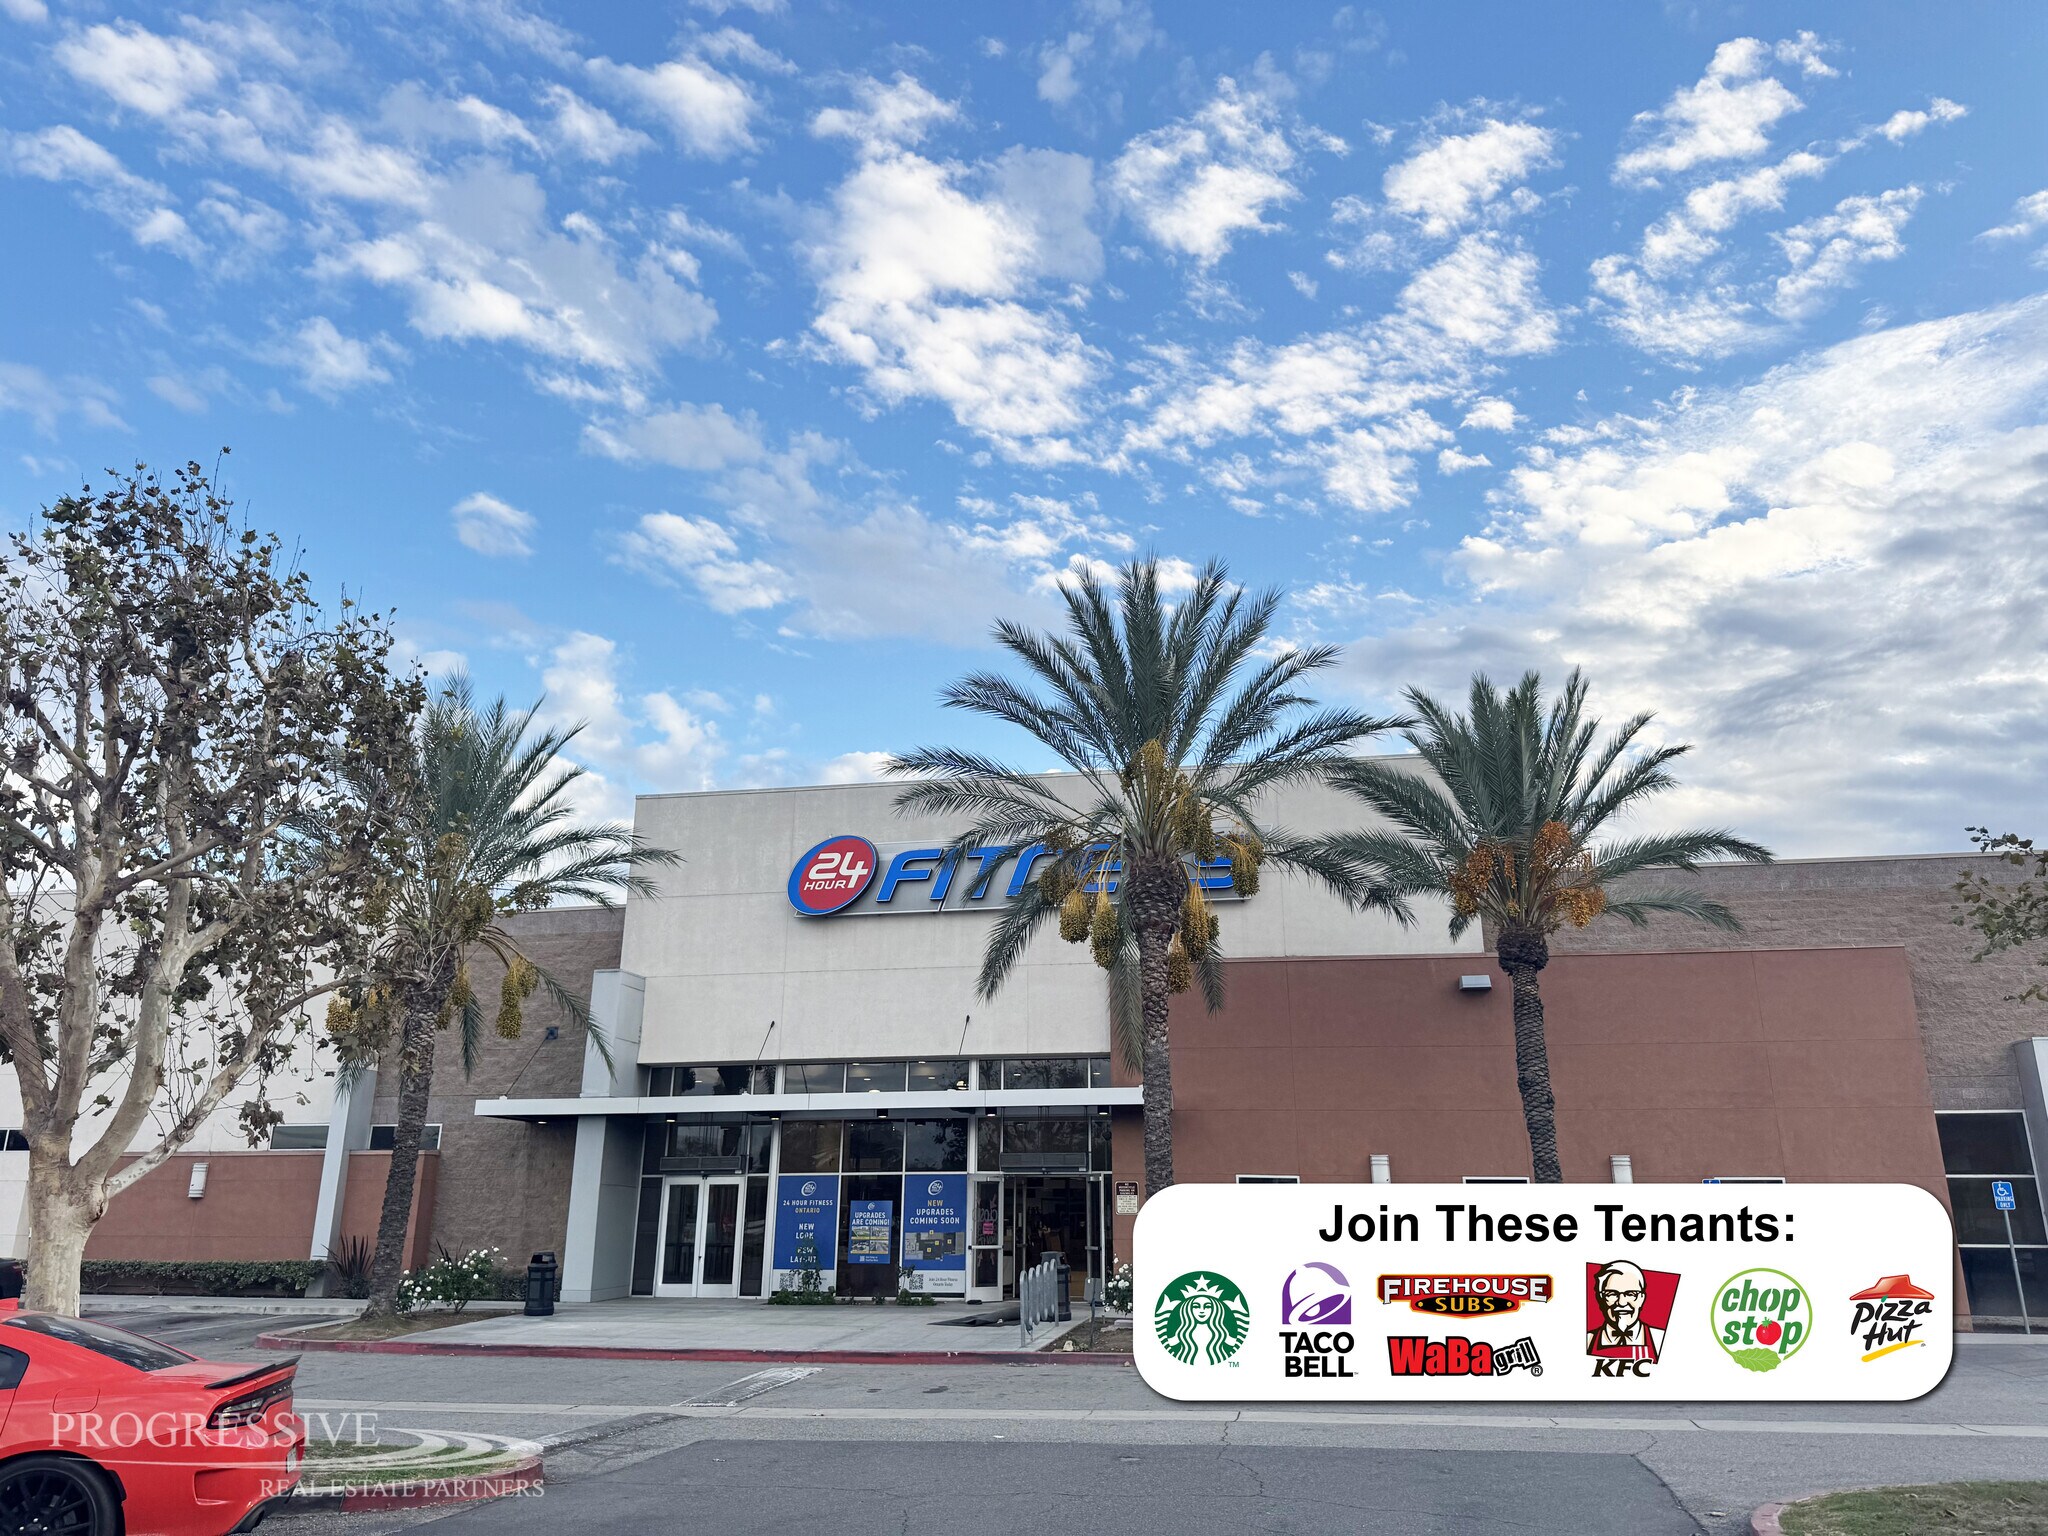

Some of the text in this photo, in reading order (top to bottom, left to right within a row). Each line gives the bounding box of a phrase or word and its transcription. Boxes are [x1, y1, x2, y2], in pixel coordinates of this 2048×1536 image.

[808, 851, 869, 889] 24
[803, 879, 847, 891] HOUR
[927, 1199, 944, 1207] NEW
[854, 1211, 886, 1219] UPGRADES
[916, 1208, 954, 1216] UPGRADES
[851, 1218, 890, 1226] ARE COMING!
[909, 1217, 960, 1225] COMING SOON
[798, 1223, 815, 1231] NEW
